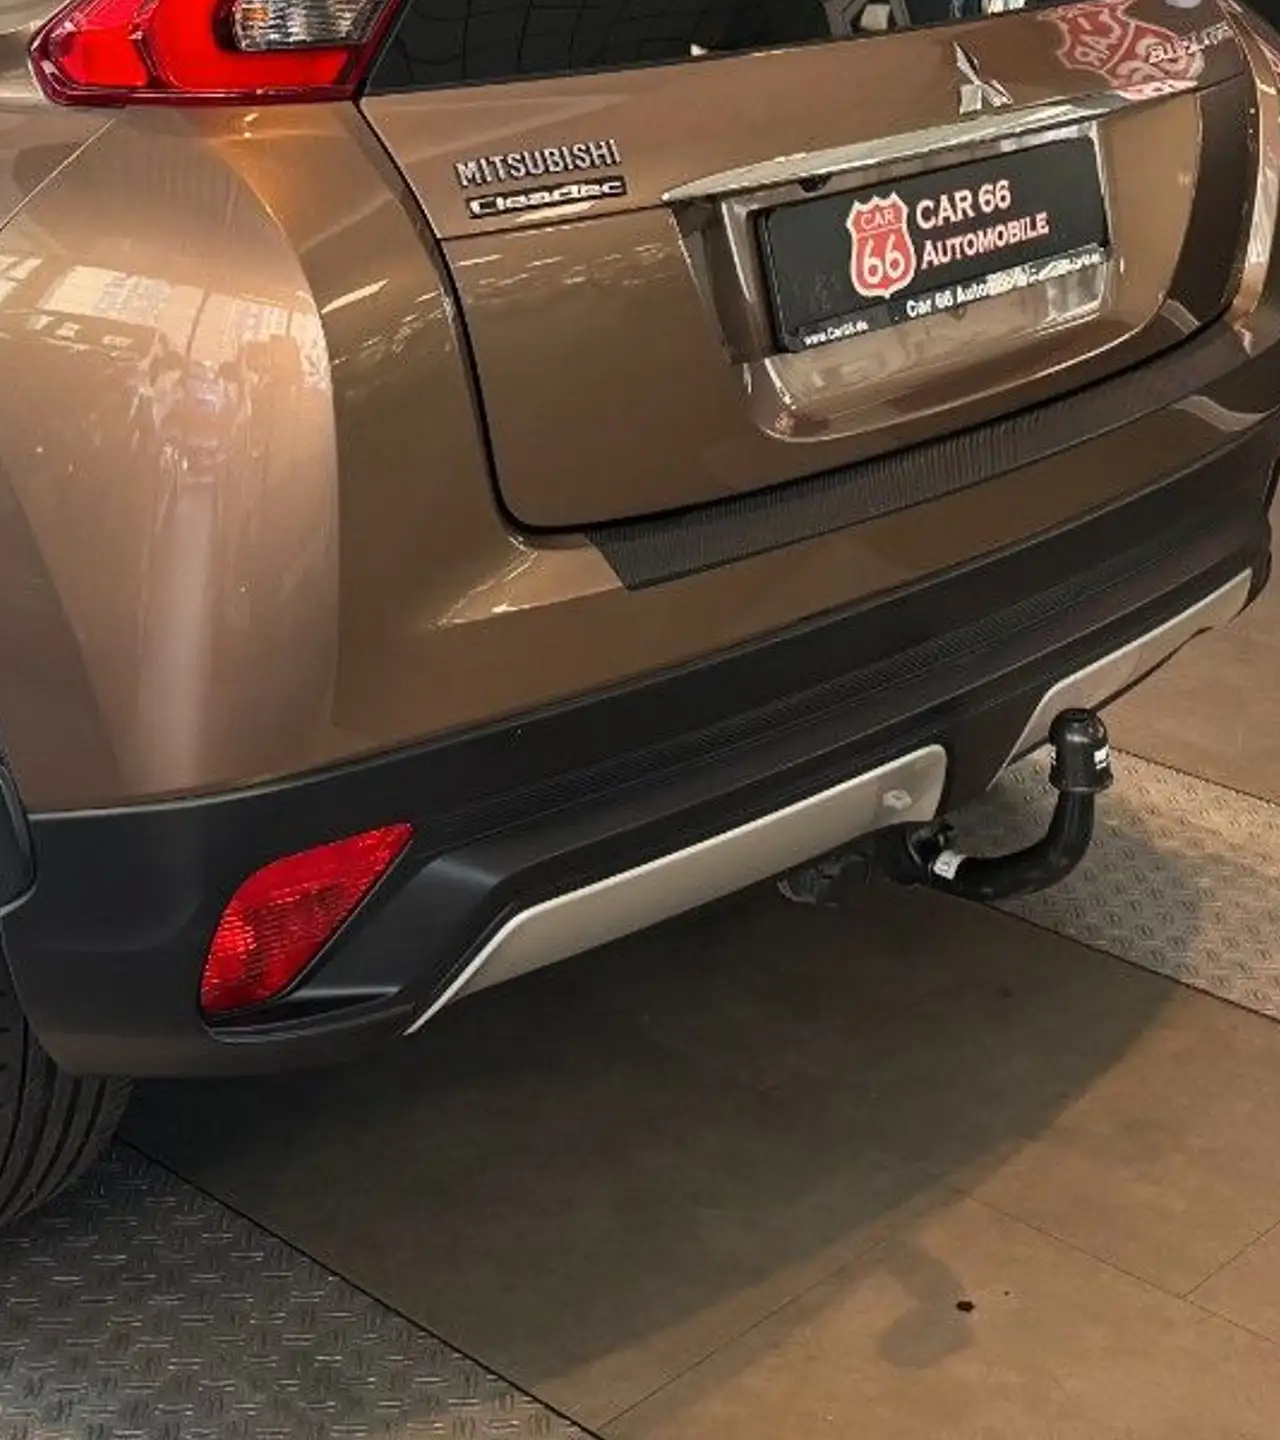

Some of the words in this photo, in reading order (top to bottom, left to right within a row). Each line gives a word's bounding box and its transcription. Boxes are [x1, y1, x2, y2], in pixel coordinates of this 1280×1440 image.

[455, 139, 621, 187] MITSUBISHI
[861, 210, 894, 230] CAR
[916, 189, 975, 229] CAR
[979, 180, 1011, 214] 66
[863, 234, 905, 284] 66
[921, 212, 1050, 269] AUTOMOBILE
[906, 299, 931, 318] Car
